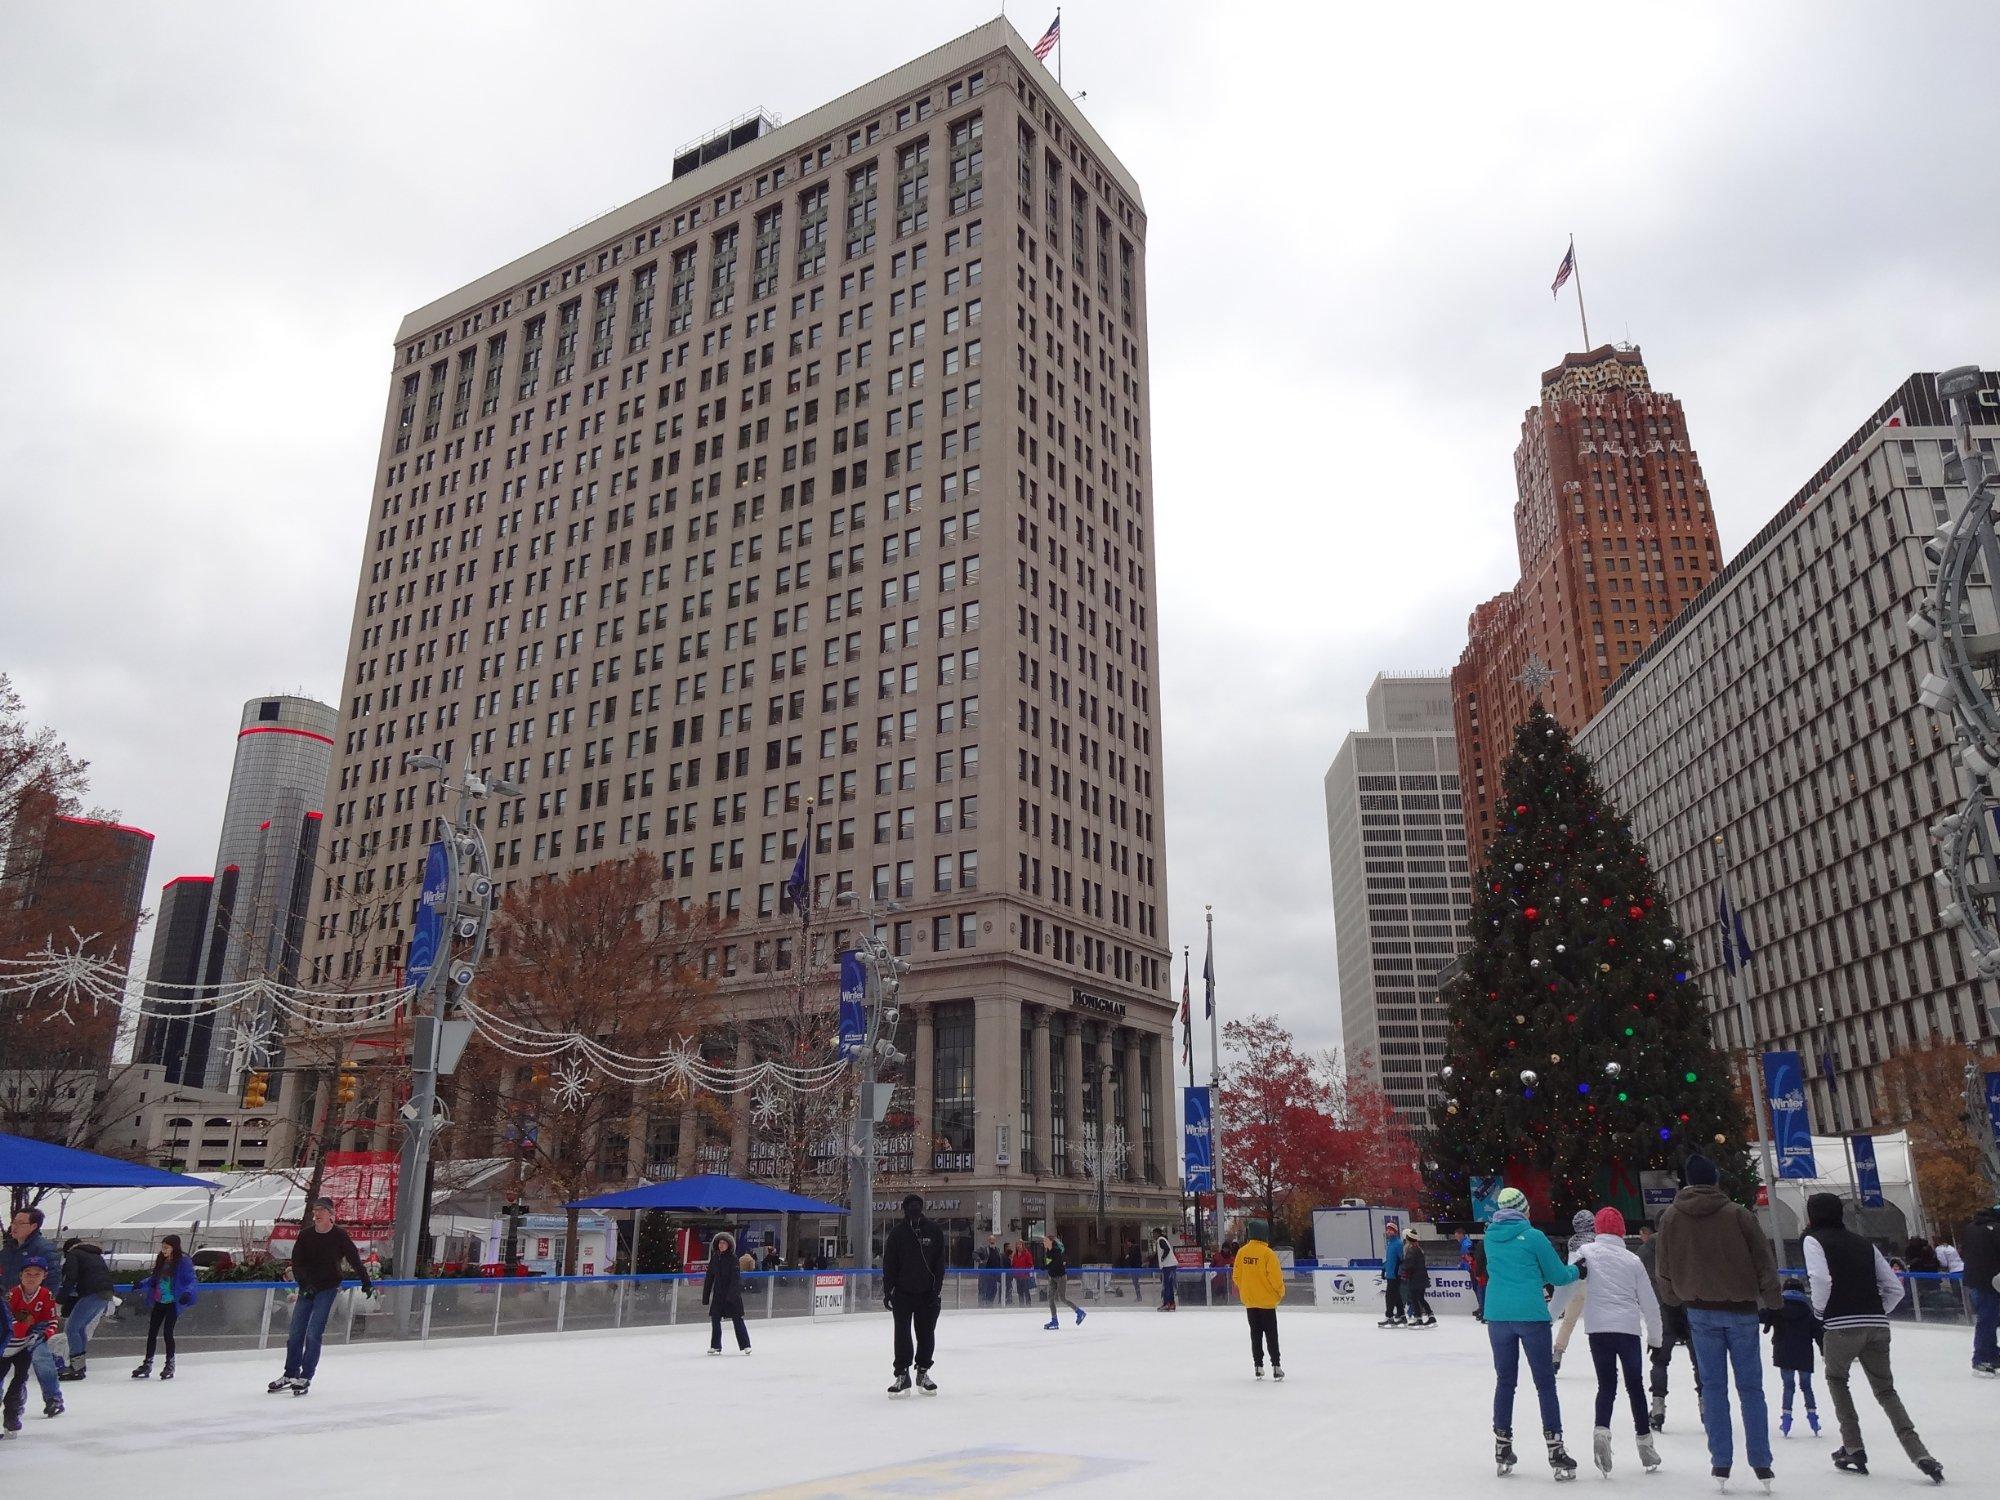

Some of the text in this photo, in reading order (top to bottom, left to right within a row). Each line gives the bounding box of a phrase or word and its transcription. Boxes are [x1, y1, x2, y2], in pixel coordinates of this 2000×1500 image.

[424, 892, 445, 905] Winter
[842, 991, 863, 1001] Winter
[1072, 987, 1126, 1017] HONIGMAN
[1770, 1097, 1804, 1109] Winter
[1185, 1124, 1209, 1135] Winter
[935, 1153, 974, 1169] CHEE
[926, 1199, 961, 1211] PLANT
[1022, 1196, 1046, 1205] ROASTING
[1026, 1205, 1043, 1213] PLANT
[1243, 1257, 1259, 1265] STAFF
[816, 1275, 843, 1285] EMERGENCY
[1435, 1277, 1473, 1289] Energ
[1425, 1290, 1461, 1298] ndation
[34, 1301, 43, 1311] C
[815, 1294, 842, 1308] EXIT ONLY
